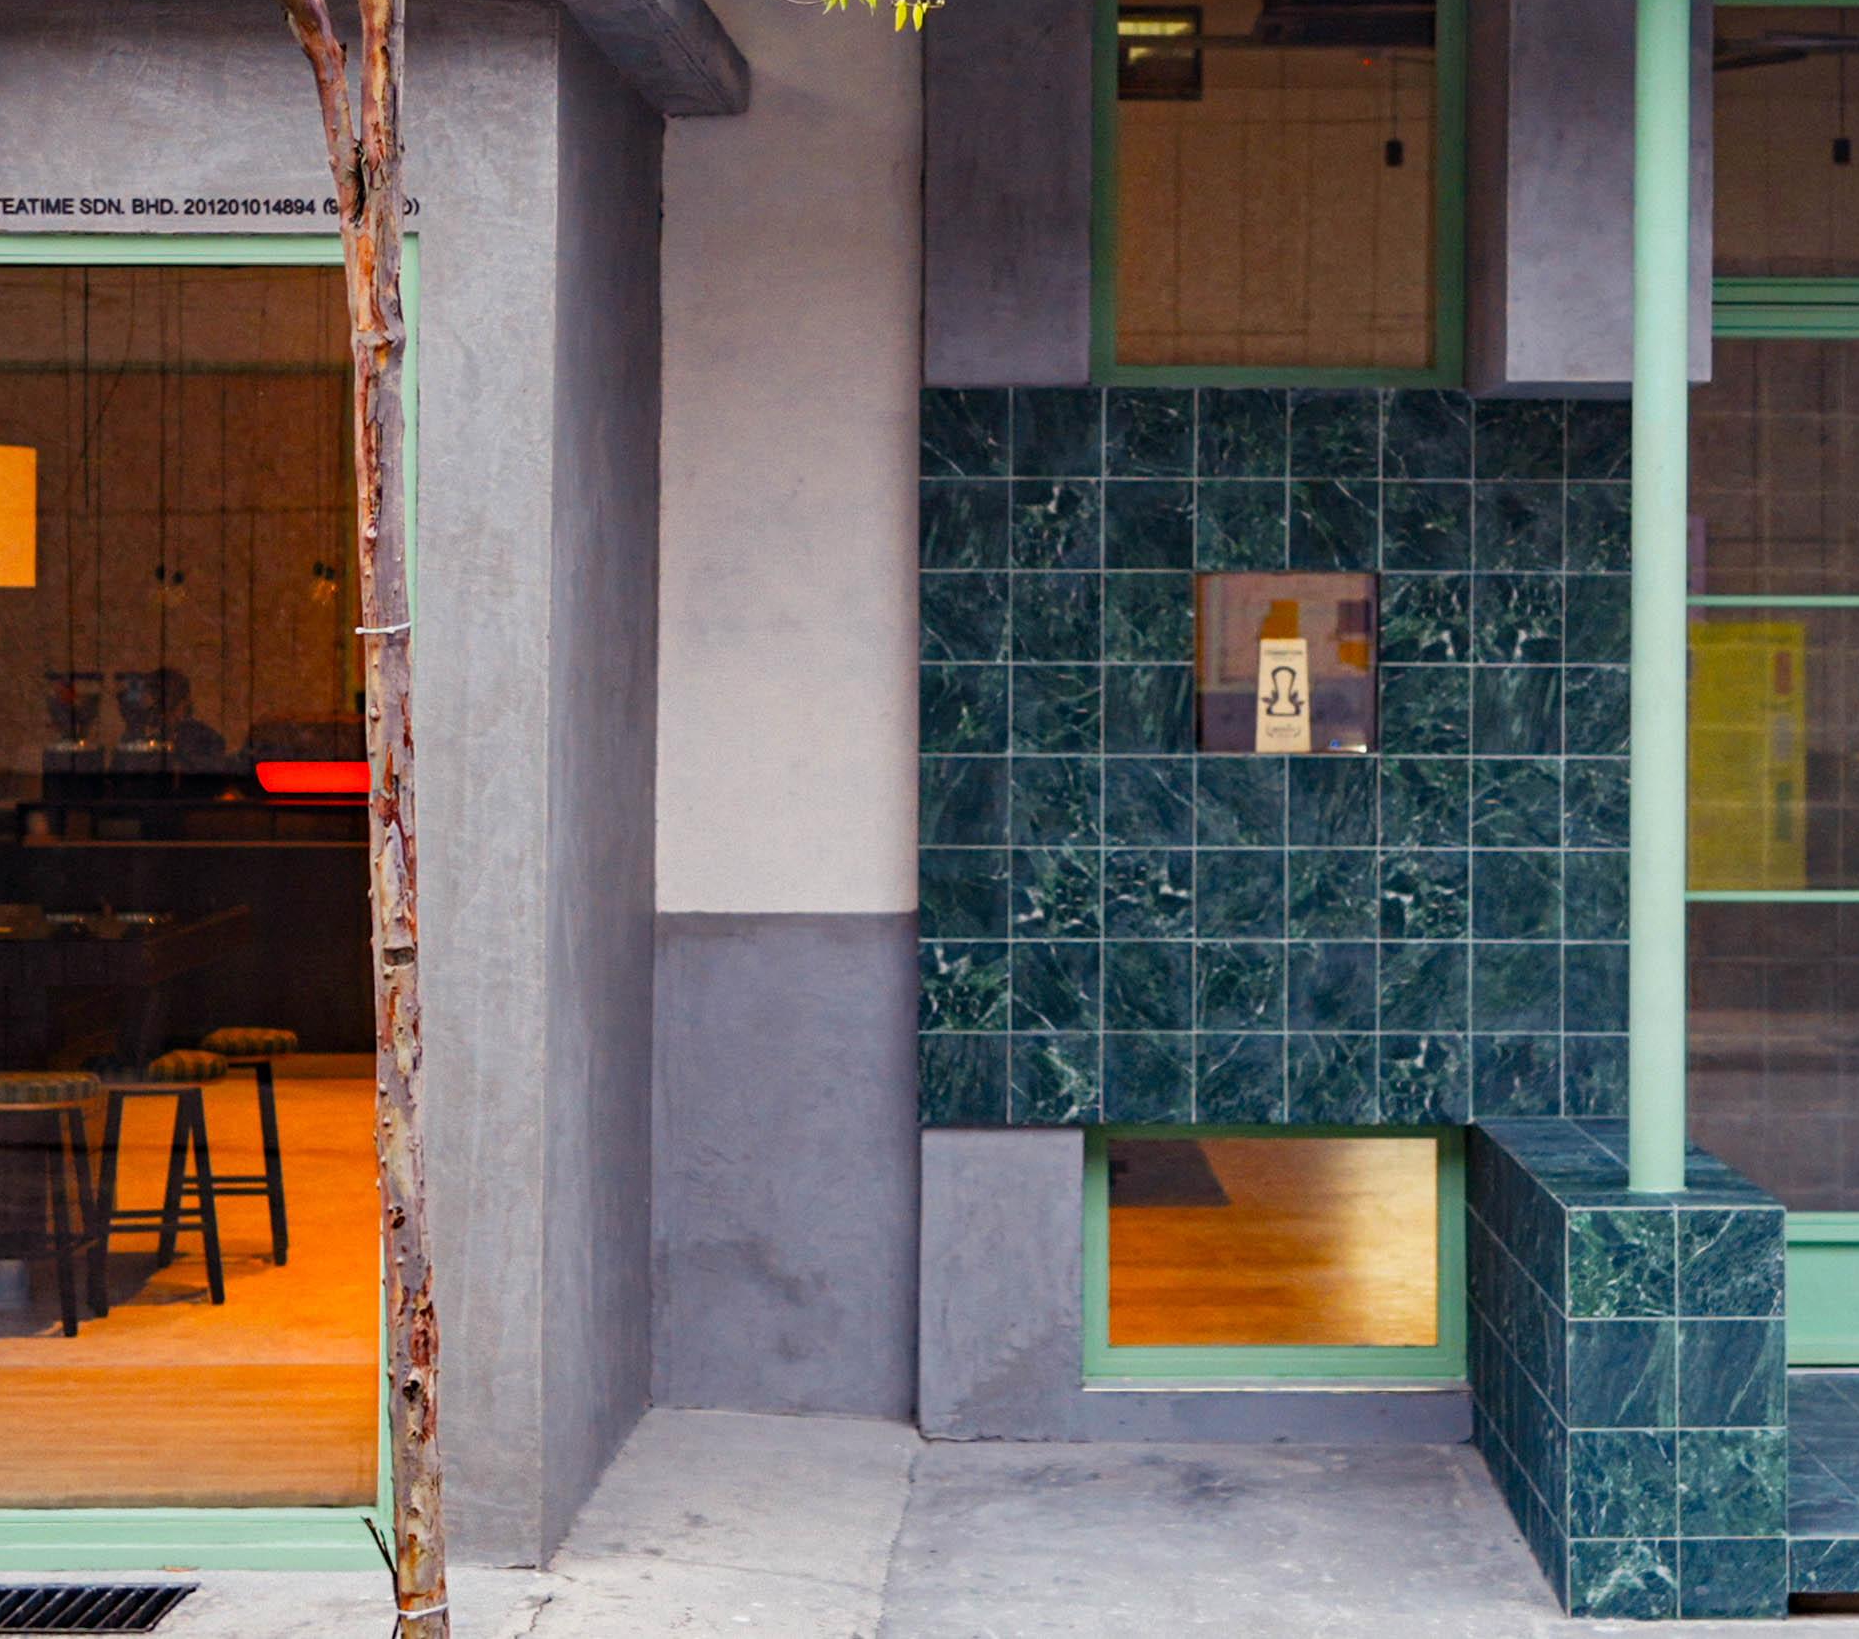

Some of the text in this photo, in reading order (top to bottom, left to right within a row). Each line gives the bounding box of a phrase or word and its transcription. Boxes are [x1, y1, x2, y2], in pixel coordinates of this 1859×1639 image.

[79, 196, 125, 216] SDN.
[130, 197, 179, 216] BHD.
[183, 197, 317, 216] 201201014894
